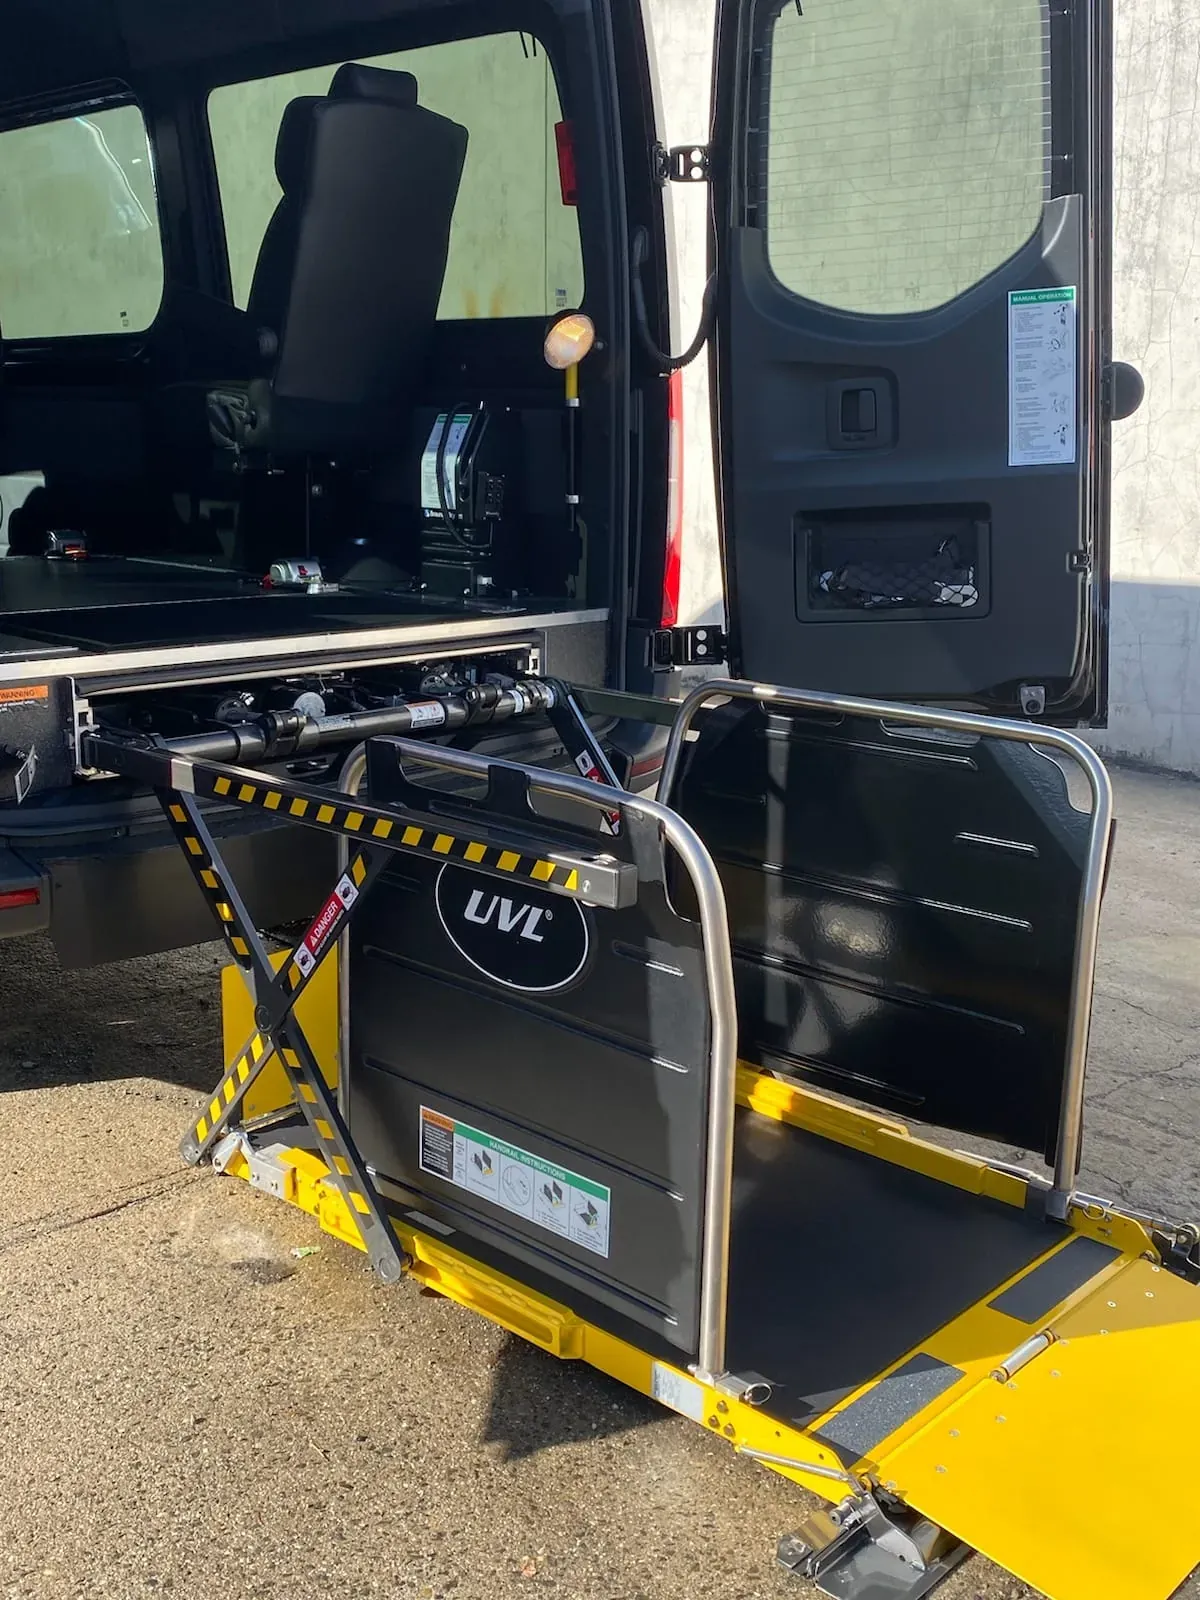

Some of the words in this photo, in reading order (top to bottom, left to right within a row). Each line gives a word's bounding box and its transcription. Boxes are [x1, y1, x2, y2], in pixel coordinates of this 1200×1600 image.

[1012, 294, 1038, 302] MANUAL
[1039, 292, 1073, 300] OPERATION
[313, 901, 338, 937] DANGER
[489, 1140, 519, 1160] HANDRAIL
[520, 1154, 566, 1180] INSTRUCTIONS
